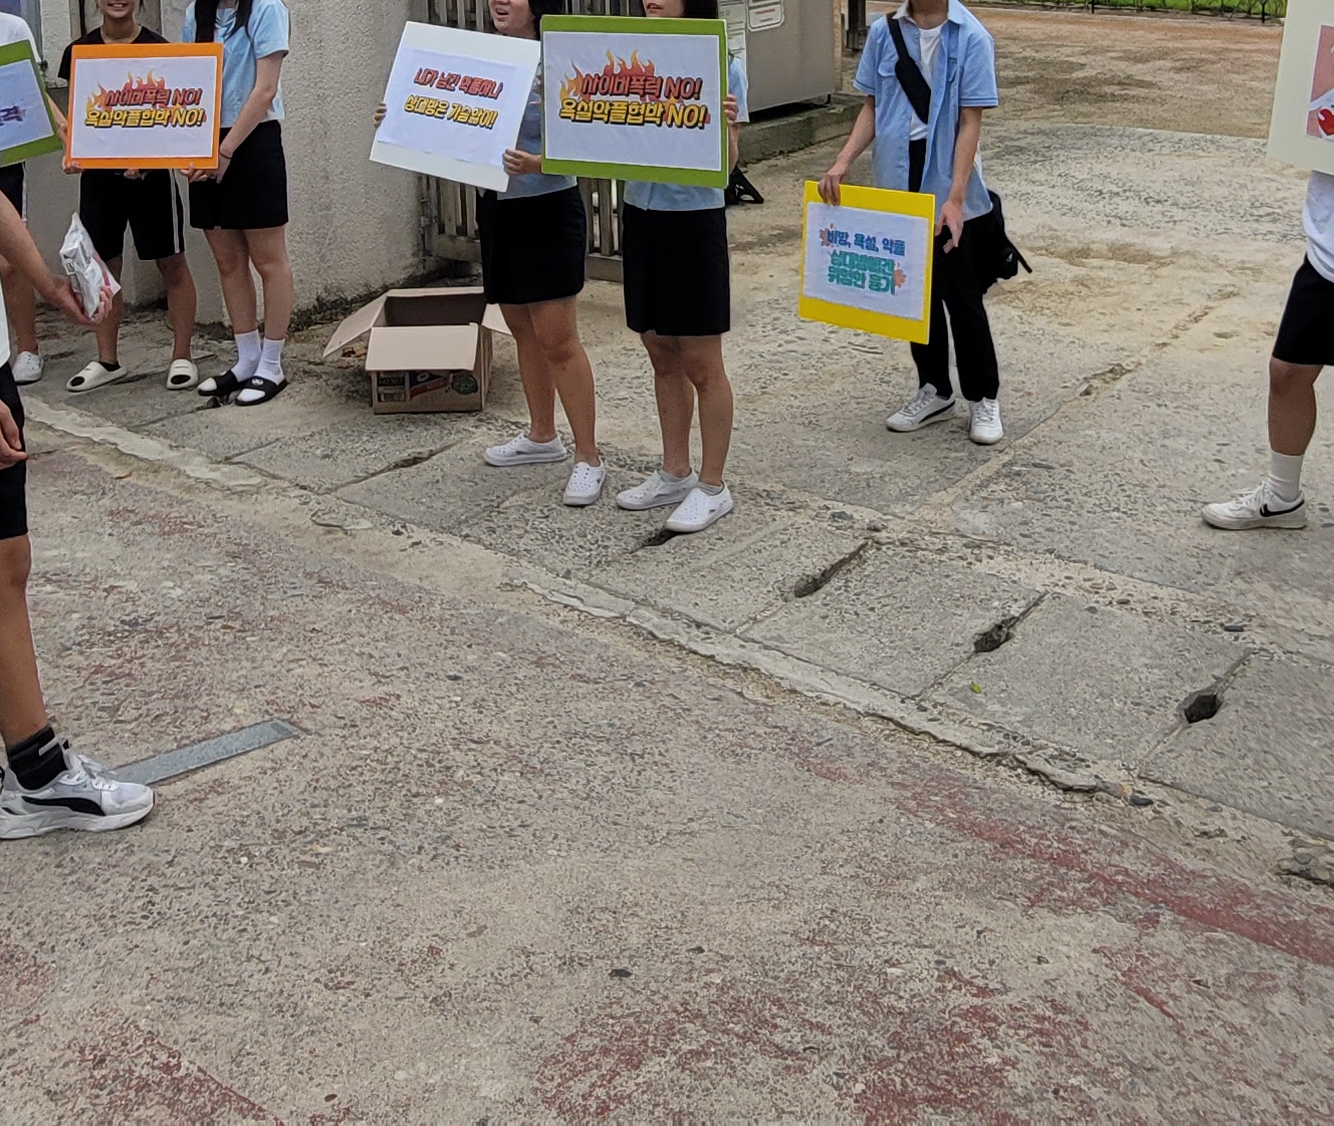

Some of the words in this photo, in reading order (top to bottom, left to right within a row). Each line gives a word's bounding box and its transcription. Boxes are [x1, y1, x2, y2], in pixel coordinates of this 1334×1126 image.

[413, 67, 439, 87] 내가
[435, 71, 462, 92] 남긴
[459, 75, 504, 100] 악플하나
[581, 73, 664, 97] 사이버폭력
[665, 76, 703, 100] NO!
[104, 88, 171, 107] 사이버폭력
[172, 88, 203, 106] NO!
[85, 108, 172, 128] 욕설악플협박
[171, 108, 204, 128] NO!
[559, 98, 666, 127] 욕설악플협박
[666, 102, 708, 130] NO!
